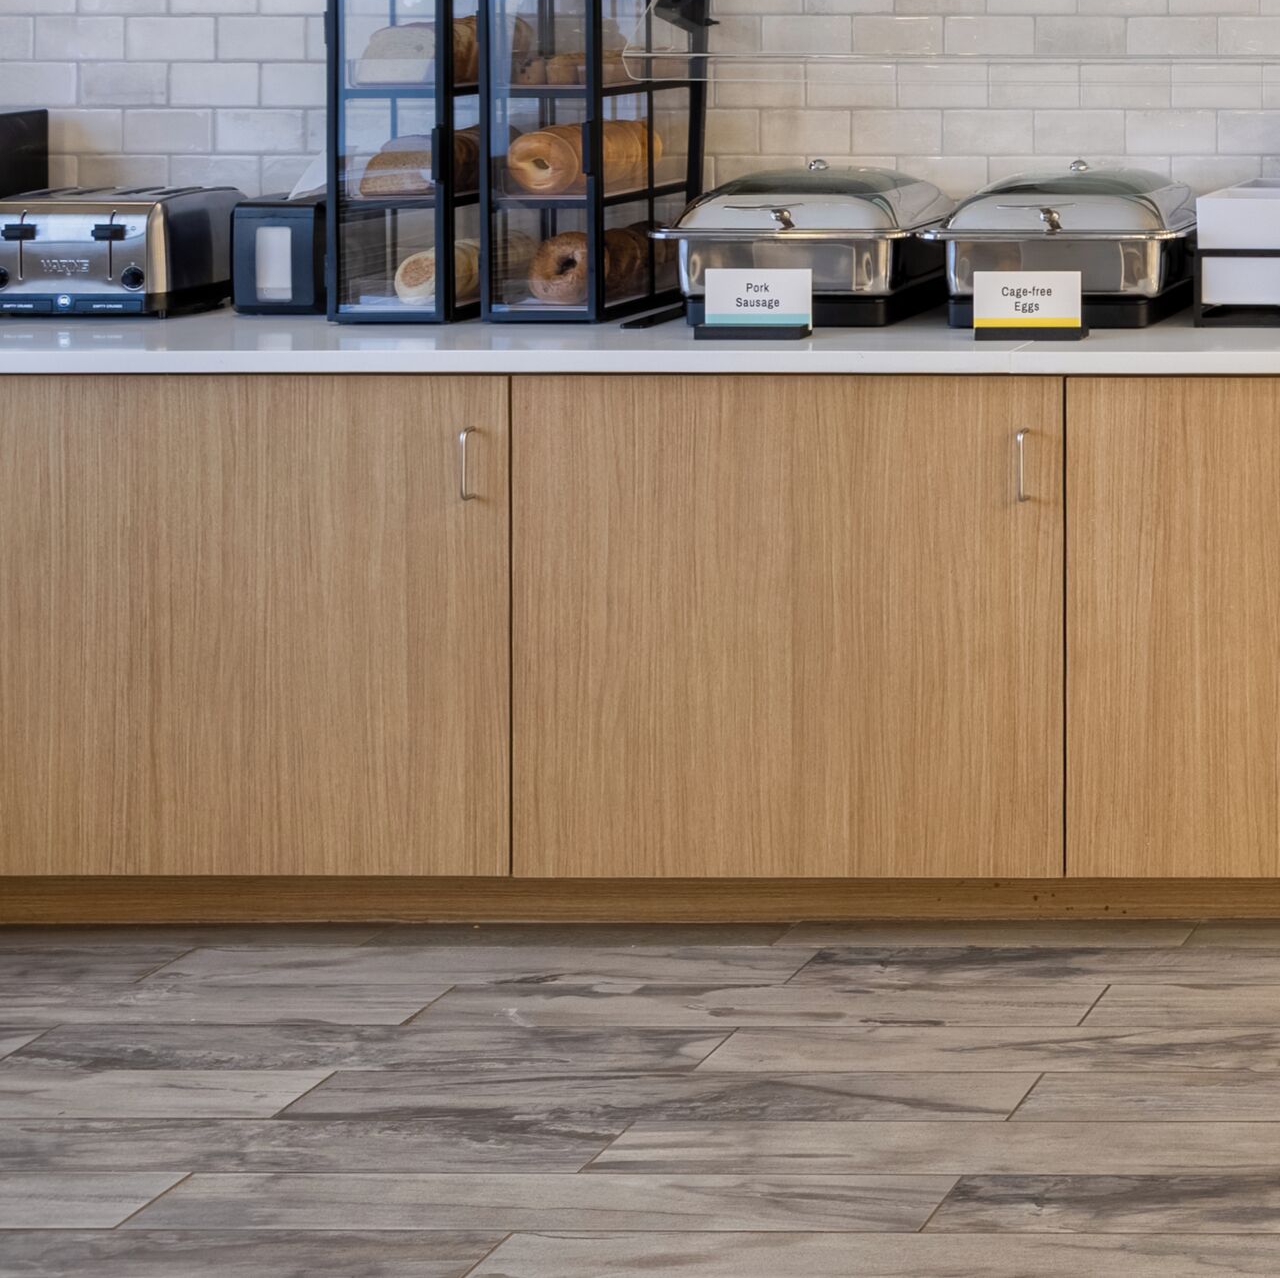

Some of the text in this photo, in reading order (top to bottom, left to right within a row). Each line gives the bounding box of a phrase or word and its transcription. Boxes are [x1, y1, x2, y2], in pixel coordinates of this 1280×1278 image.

[746, 282, 769, 293] Pork
[1001, 286, 1052, 299] Cage-free
[735, 297, 780, 310] Sausage
[1014, 301, 1040, 314] Eggs
